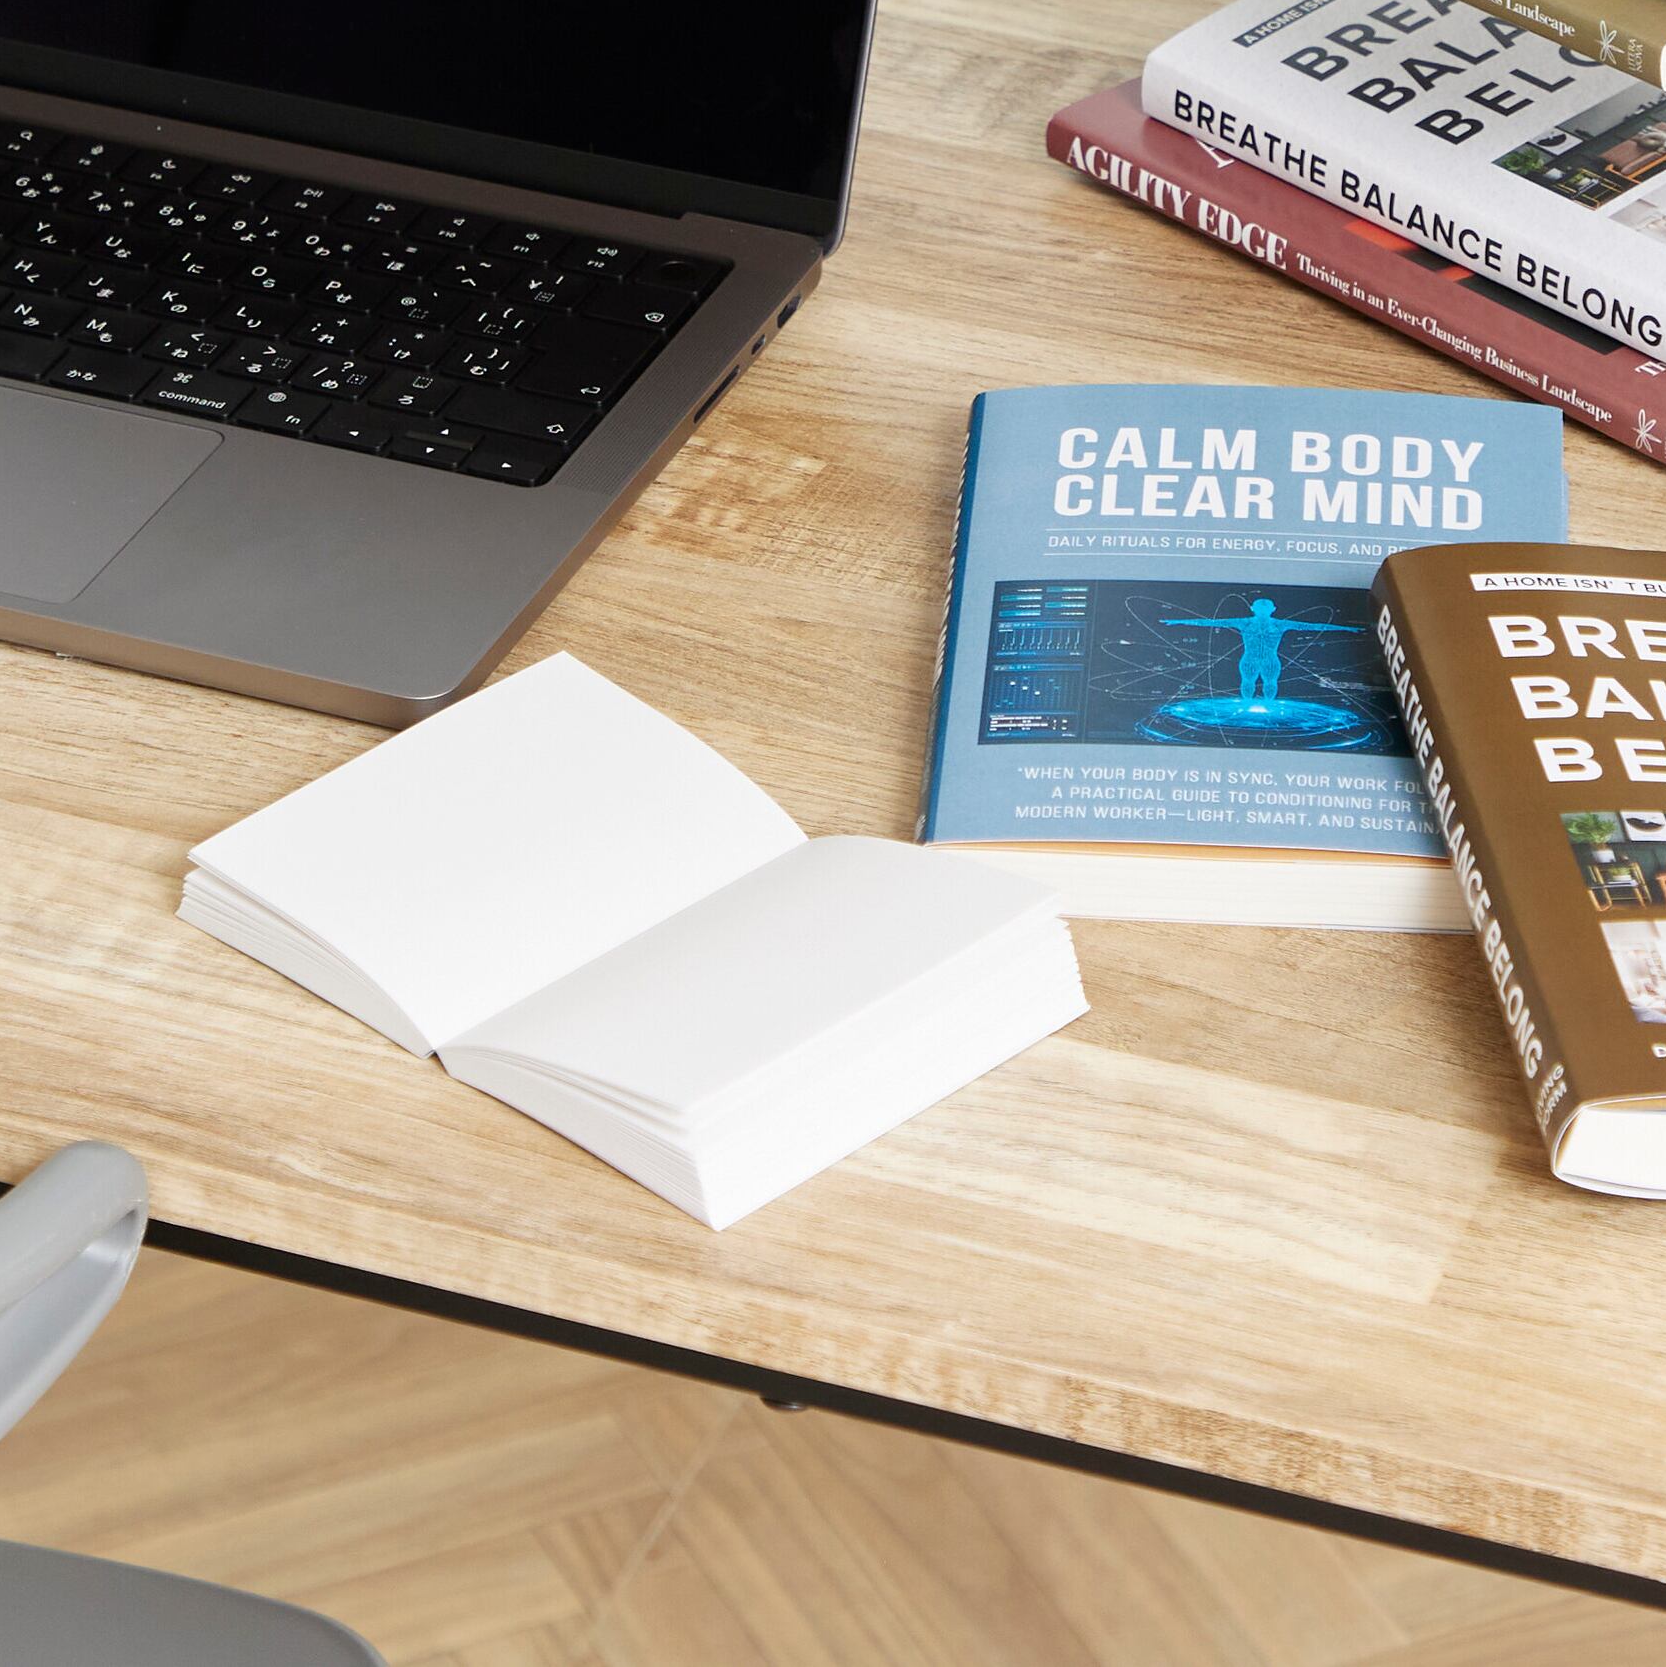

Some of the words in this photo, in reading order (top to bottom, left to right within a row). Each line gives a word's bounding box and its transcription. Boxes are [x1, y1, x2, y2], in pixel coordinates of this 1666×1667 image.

[1066, 135, 1192, 221] AGILITY
[1197, 197, 1288, 271] EDGE
[1173, 89, 1327, 187] BREATHE
[1341, 169, 1502, 272] BALANCE
[1517, 253, 1663, 347] BELONG
[66, 369, 97, 381] かな
[158, 389, 226, 411] command
[1057, 426, 1257, 471] CALM
[1290, 430, 1485, 482] BODY
[1053, 473, 1274, 519] CLEAR
[1303, 480, 1484, 530] MIND
[1048, 535, 1097, 549] DAILY
[1102, 535, 1170, 550] RITUALS
[1175, 537, 1206, 551] FOR
[1348, 543, 1383, 557] AND
[1484, 576, 1498, 587] A
[1503, 577, 1569, 589] HOME
[1377, 604, 1435, 767] BREATHE
[1427, 759, 1491, 931] BALANCE
[1484, 919, 1543, 1079] BELONG
